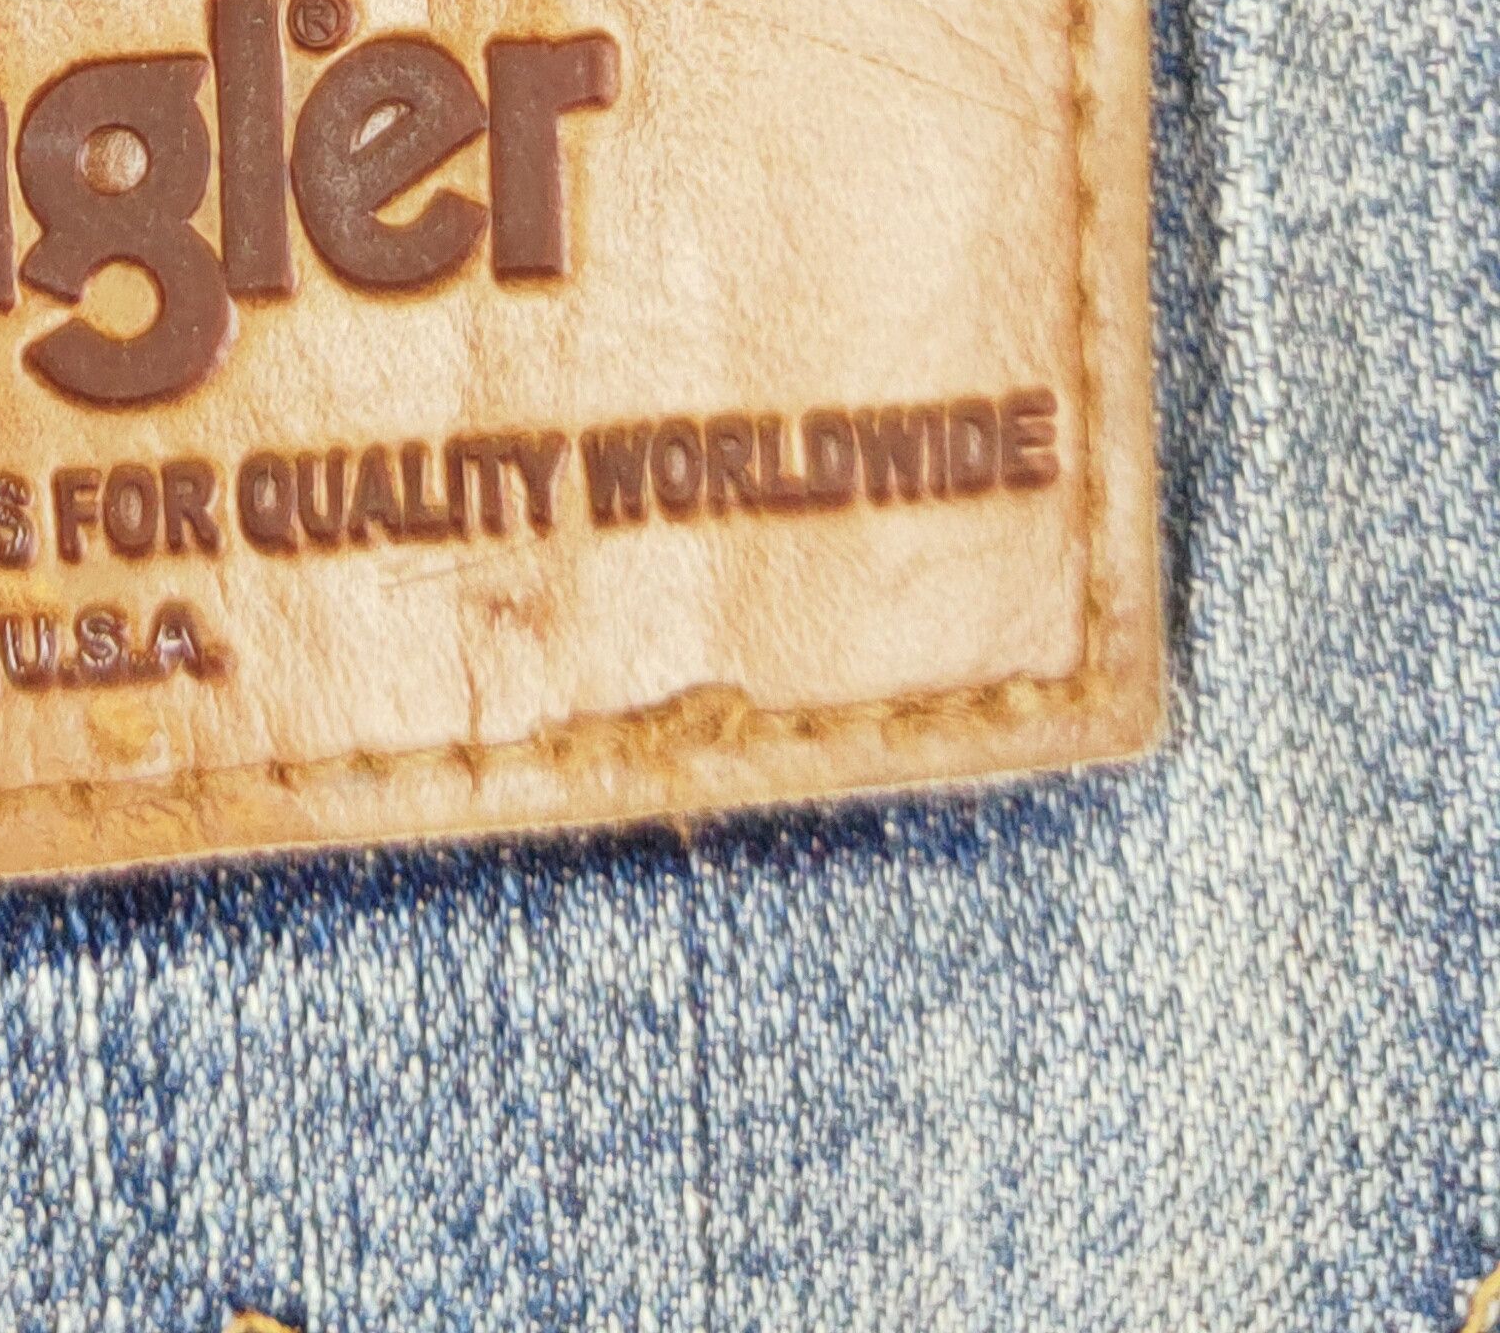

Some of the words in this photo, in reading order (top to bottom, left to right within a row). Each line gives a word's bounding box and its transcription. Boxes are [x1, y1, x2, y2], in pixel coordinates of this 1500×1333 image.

[52, 459, 220, 563] FOR
[237, 431, 568, 555] QUALITY
[580, 387, 1058, 529] WORLDWIDE
